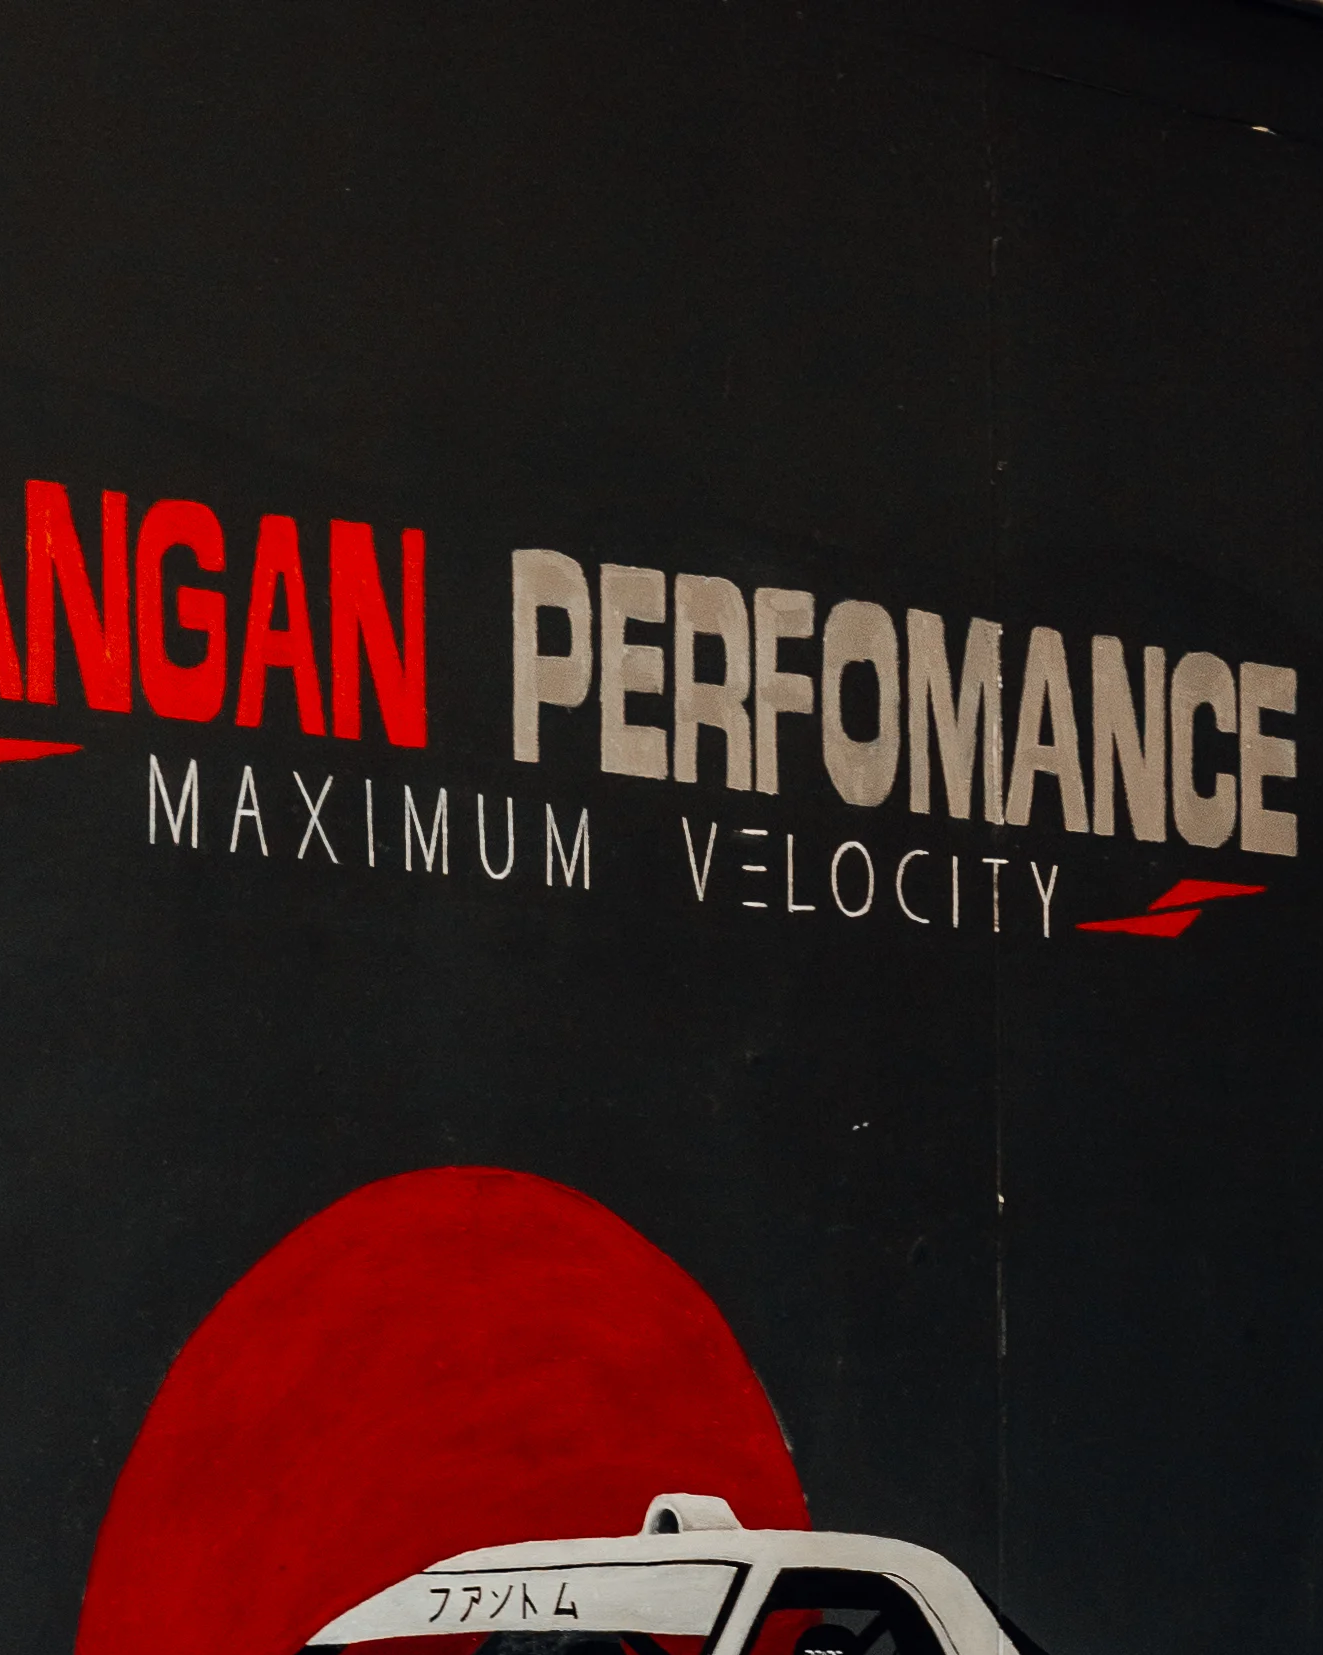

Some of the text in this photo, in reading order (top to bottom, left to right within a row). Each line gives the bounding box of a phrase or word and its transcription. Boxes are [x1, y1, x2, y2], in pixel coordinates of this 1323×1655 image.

[511, 549, 1297, 857] PERFOMANCE
[148, 753, 1060, 938] MAXIMUM VELOCITY
